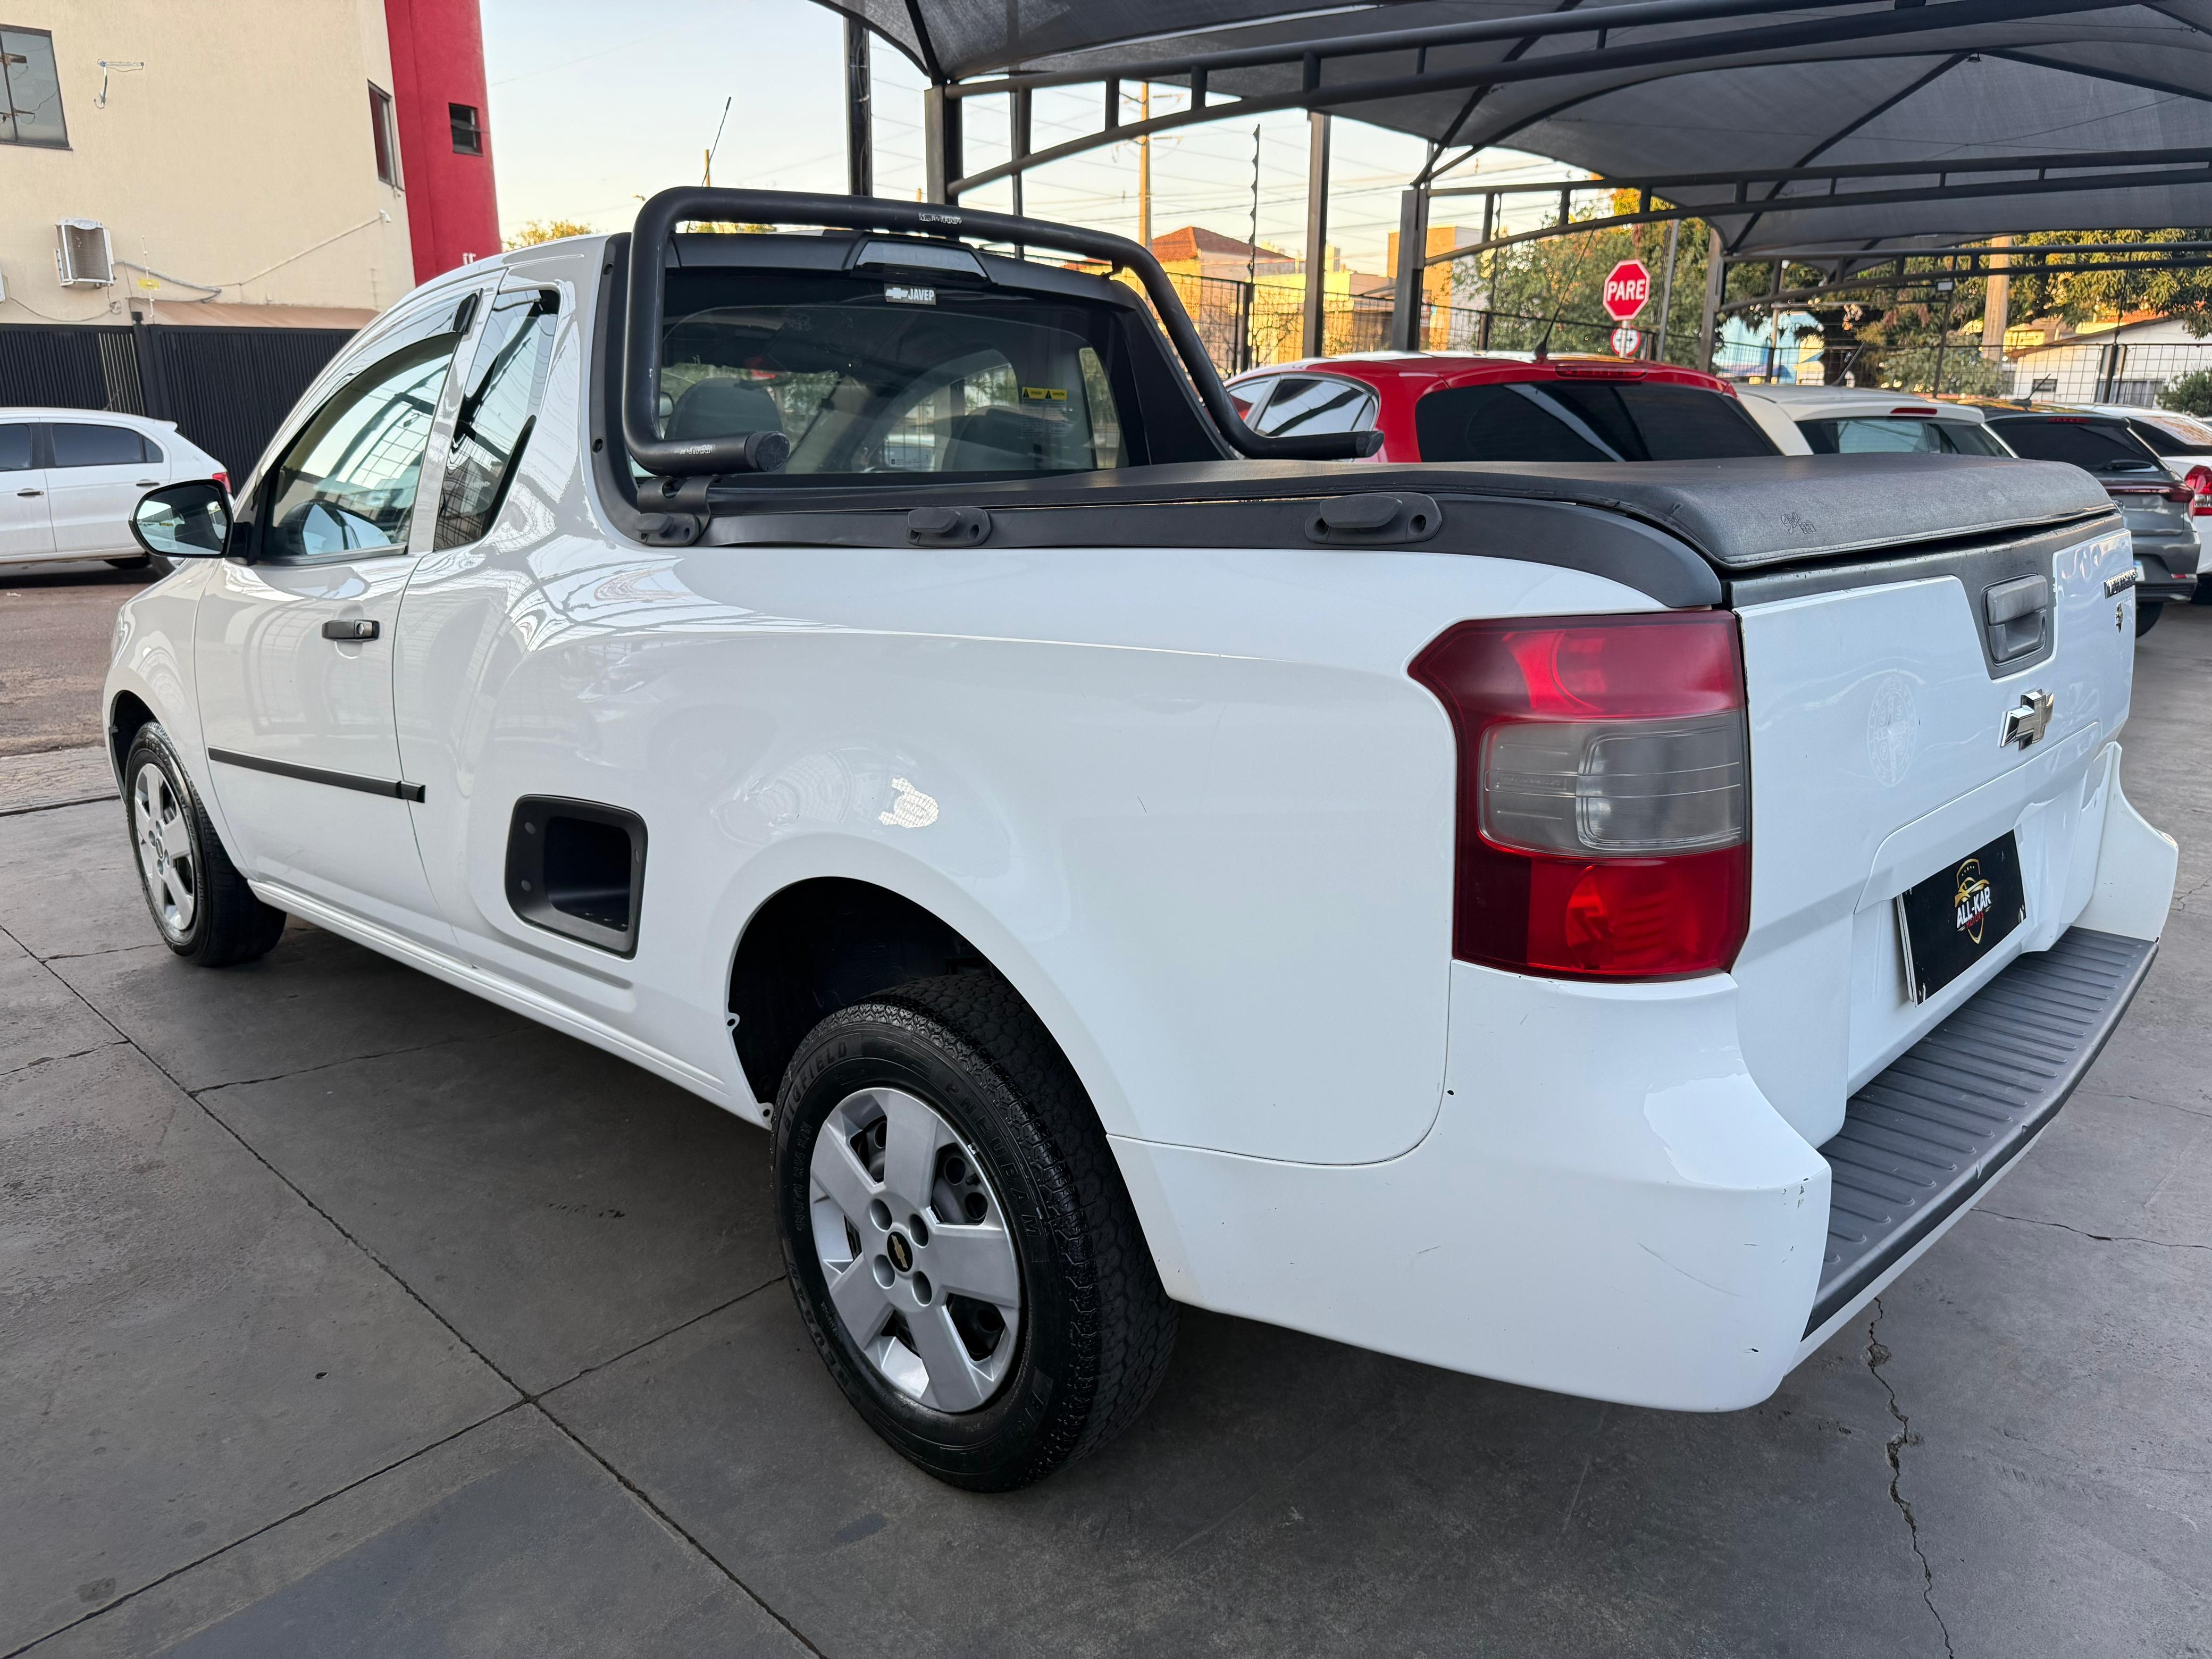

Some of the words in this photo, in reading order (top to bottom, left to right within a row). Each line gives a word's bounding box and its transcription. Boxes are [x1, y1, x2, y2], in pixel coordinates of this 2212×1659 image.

[908, 288, 935, 301] JAVEP
[1607, 278, 1646, 302] PARE
[1956, 886, 1991, 928] ALL-KAR
[1966, 911, 1984, 930] MOTORS
[946, 1080, 1042, 1237] PNEUBAM
